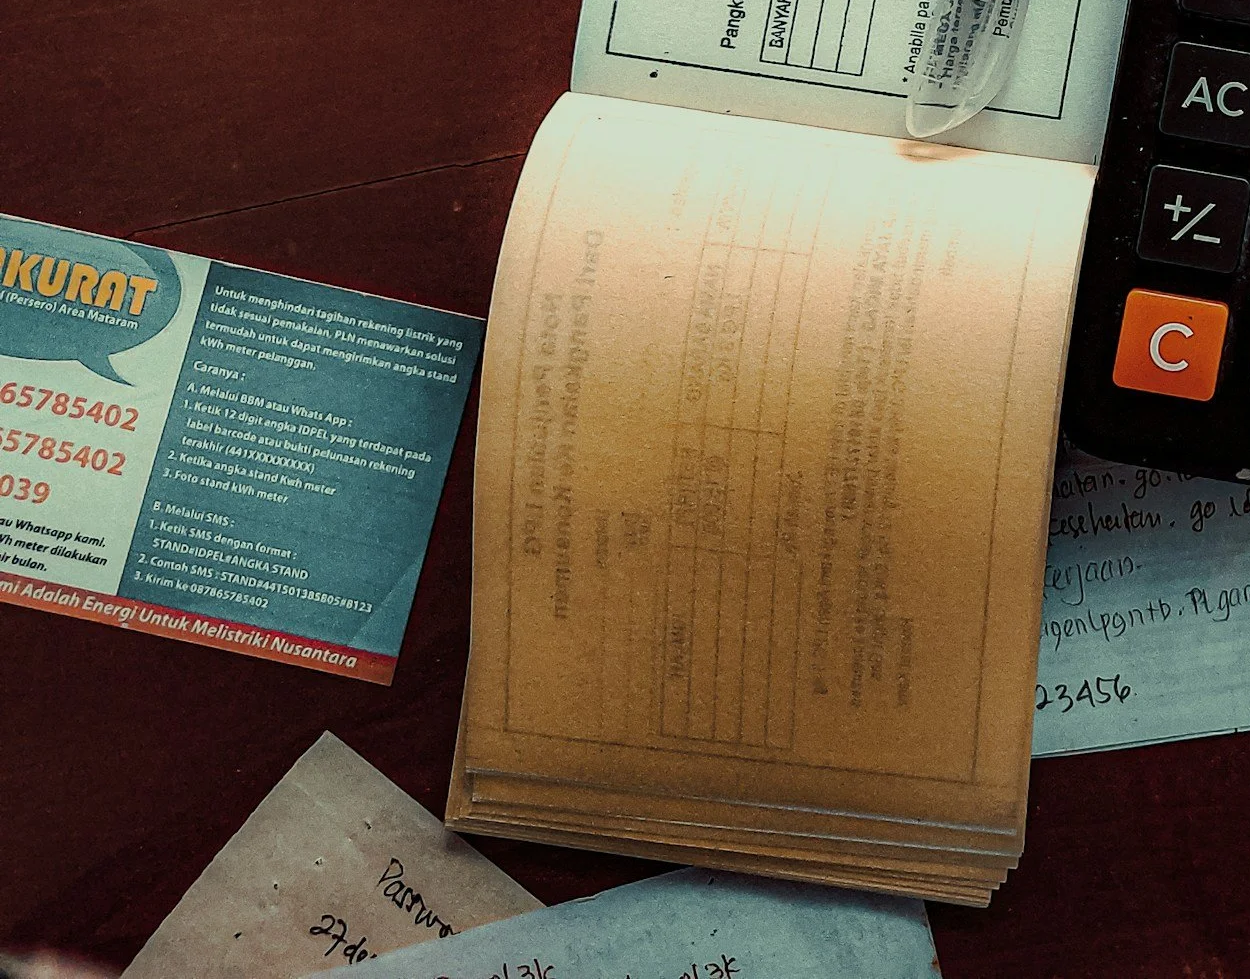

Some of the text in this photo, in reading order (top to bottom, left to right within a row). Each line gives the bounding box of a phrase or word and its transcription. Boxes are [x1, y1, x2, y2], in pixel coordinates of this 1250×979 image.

[1181, 76, 1249, 117] AC
[0, 248, 158, 317] KURAT
[5, 291, 138, 331] (Persero) Area Mataram
[210, 302, 238, 318] tidak
[333, 329, 356, 343] PLN
[424, 352, 456, 365] solusi
[215, 285, 248, 301] Untuk
[357, 319, 404, 339] rekening
[435, 336, 463, 352] yang
[1149, 322, 1194, 372] C
[13, 539, 108, 566] meter dilakukan
[15, 518, 73, 542] Whatsapp
[19, 583, 358, 668] Adalah Energi Untuk Melistriki Nusantara
